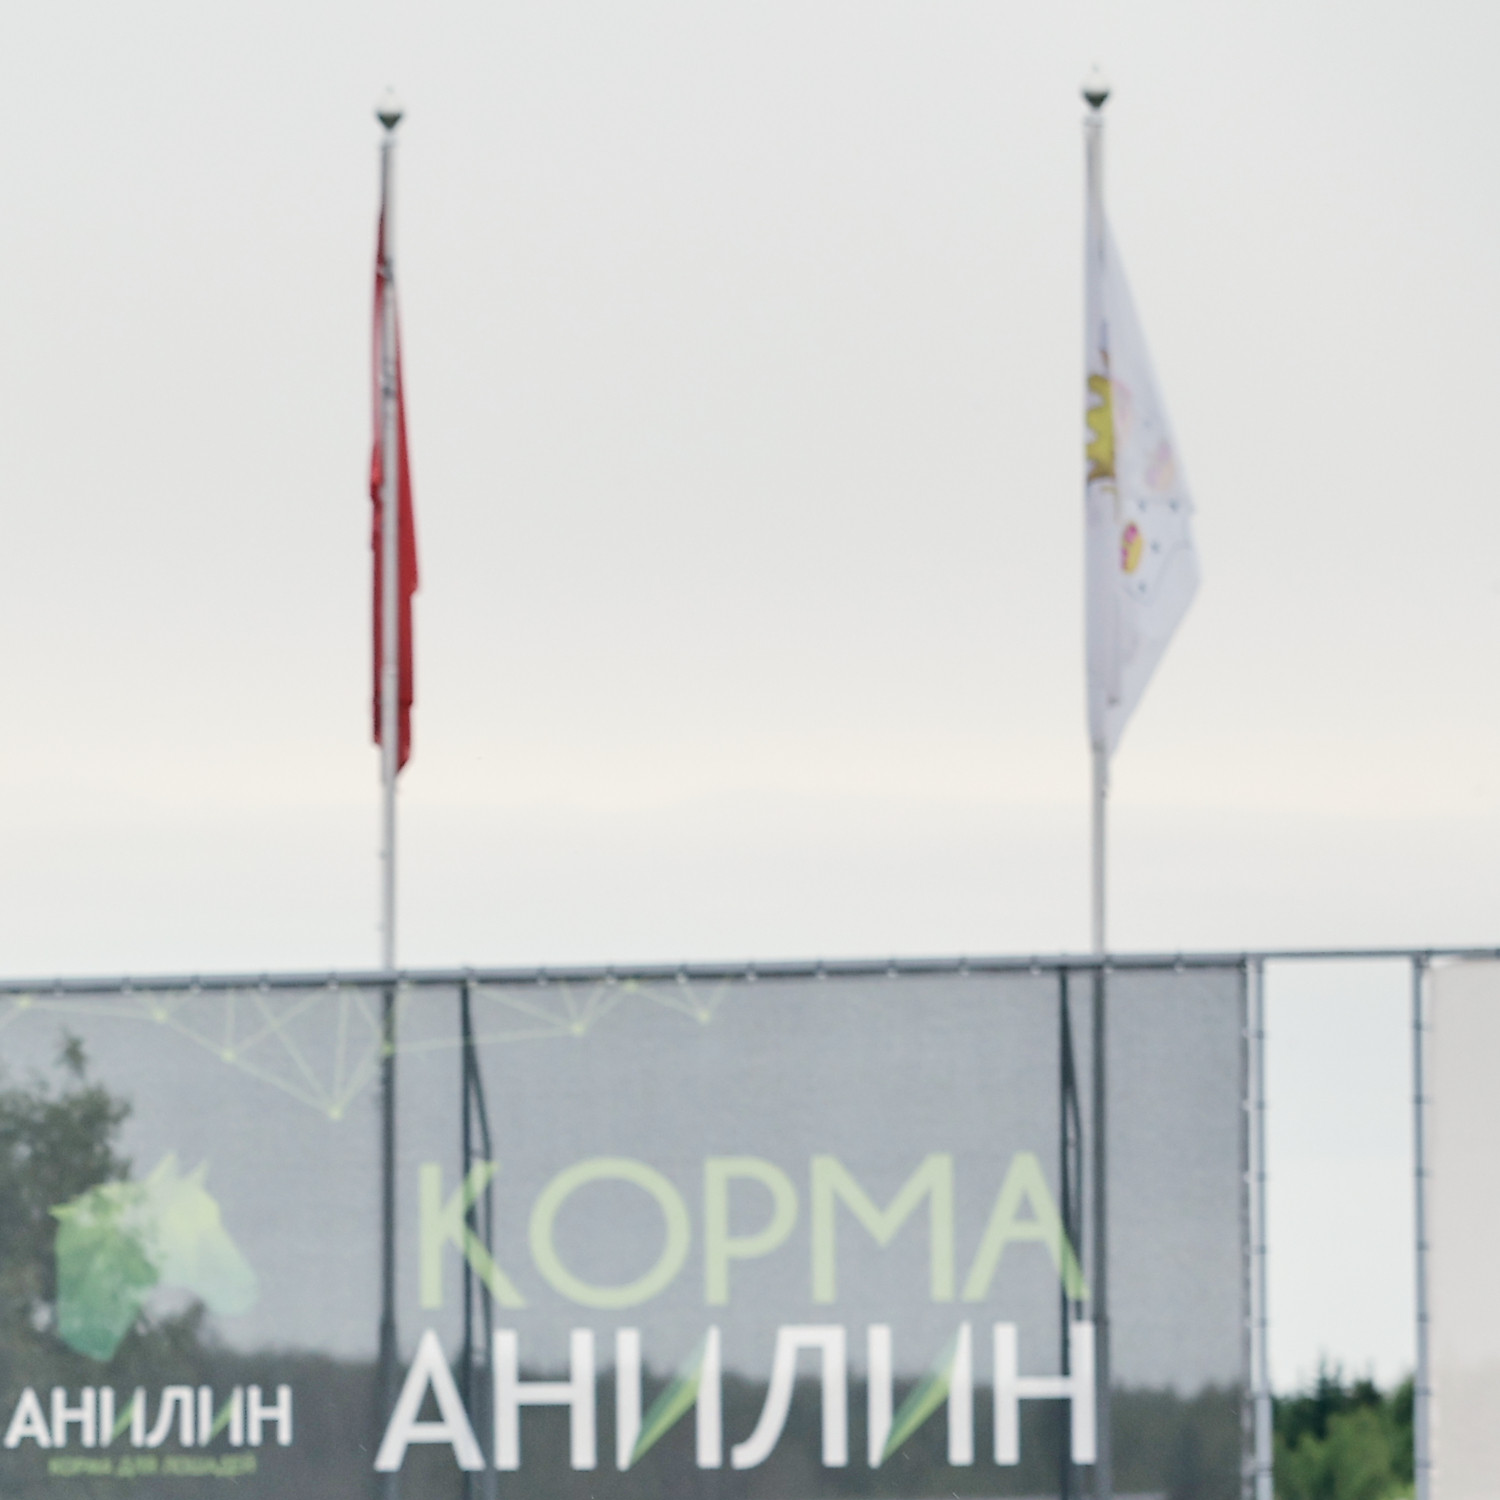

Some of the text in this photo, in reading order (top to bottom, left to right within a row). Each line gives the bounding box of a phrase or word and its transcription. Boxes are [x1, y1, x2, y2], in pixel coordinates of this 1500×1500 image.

[418, 1150, 1090, 1311] КОРМА
[3, 1384, 293, 1450] АНИЛИН
[375, 1321, 1097, 1472] АНИЛИН
